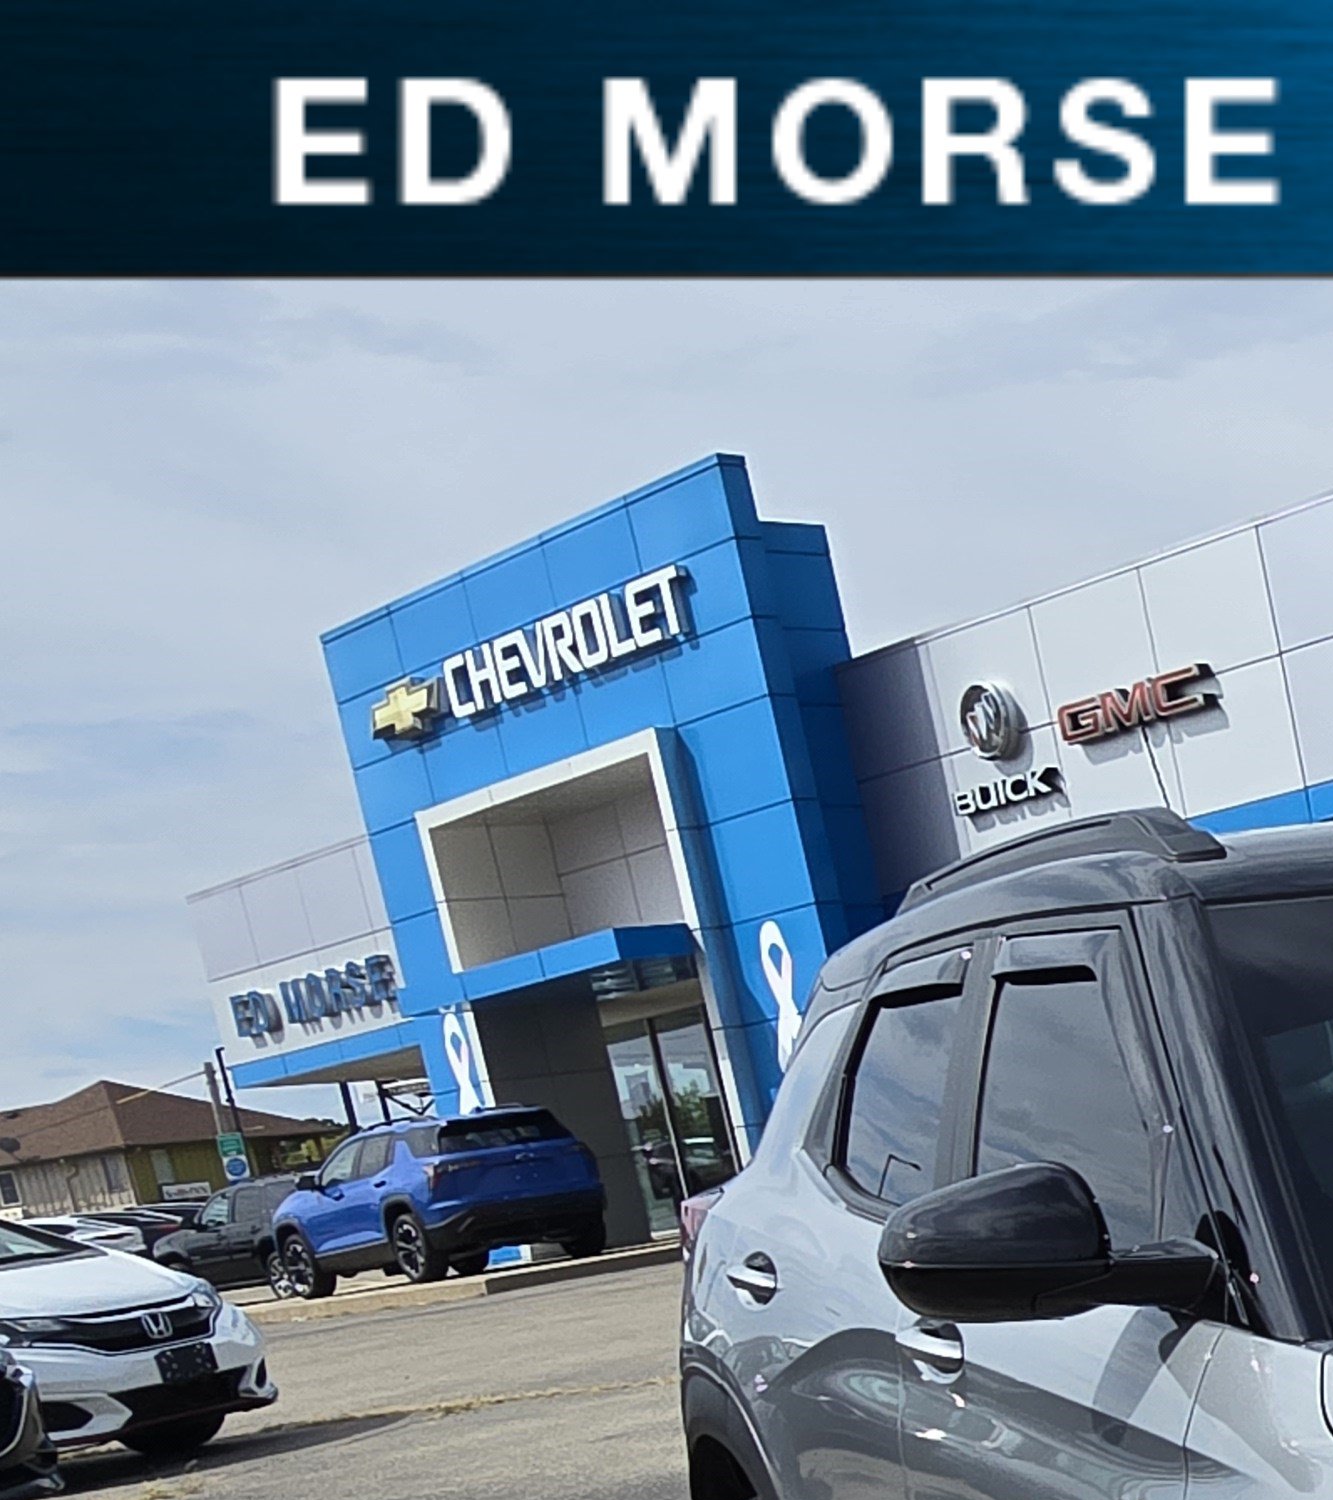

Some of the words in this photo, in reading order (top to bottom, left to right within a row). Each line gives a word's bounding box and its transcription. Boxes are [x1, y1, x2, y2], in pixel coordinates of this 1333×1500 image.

[442, 564, 687, 719] CHEVROLET
[1056, 664, 1212, 744] GMC
[955, 768, 1058, 817] BUICK
[230, 990, 281, 1037] ED
